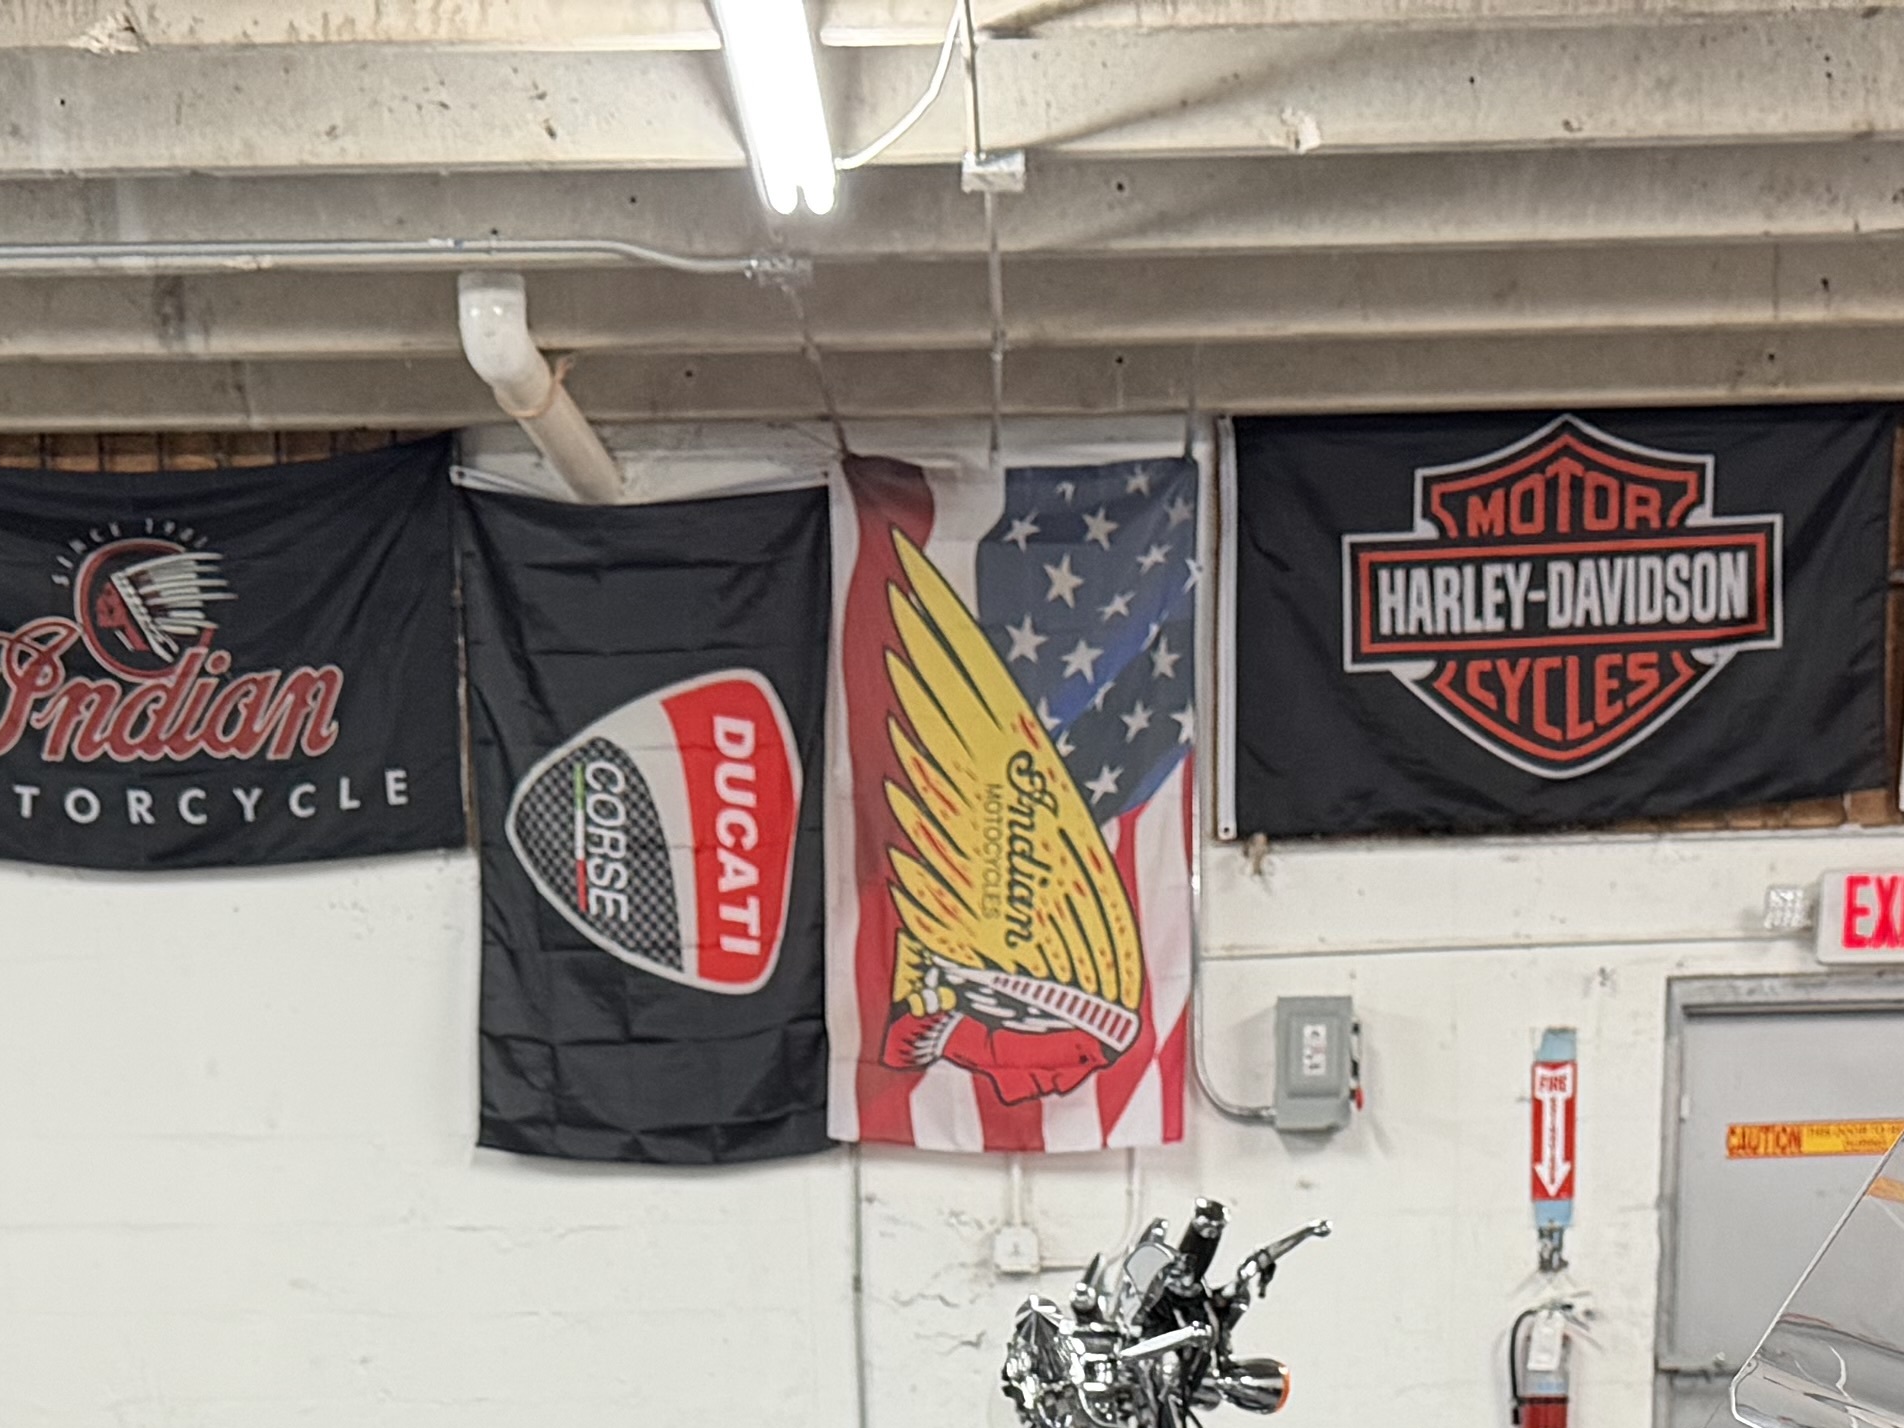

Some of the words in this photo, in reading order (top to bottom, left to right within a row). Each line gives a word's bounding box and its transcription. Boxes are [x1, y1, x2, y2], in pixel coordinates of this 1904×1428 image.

[1466, 456, 1662, 538] MOTOR
[51, 521, 122, 587] SINCE
[1377, 549, 1750, 636] HARLEY-DAVIDSON
[1464, 651, 1662, 742] CYCLES
[582, 760, 631, 923] CORSE
[710, 715, 762, 956] DUCATI
[1005, 750, 1060, 949] Indian
[1540, 1074, 1567, 1092] FIRE
